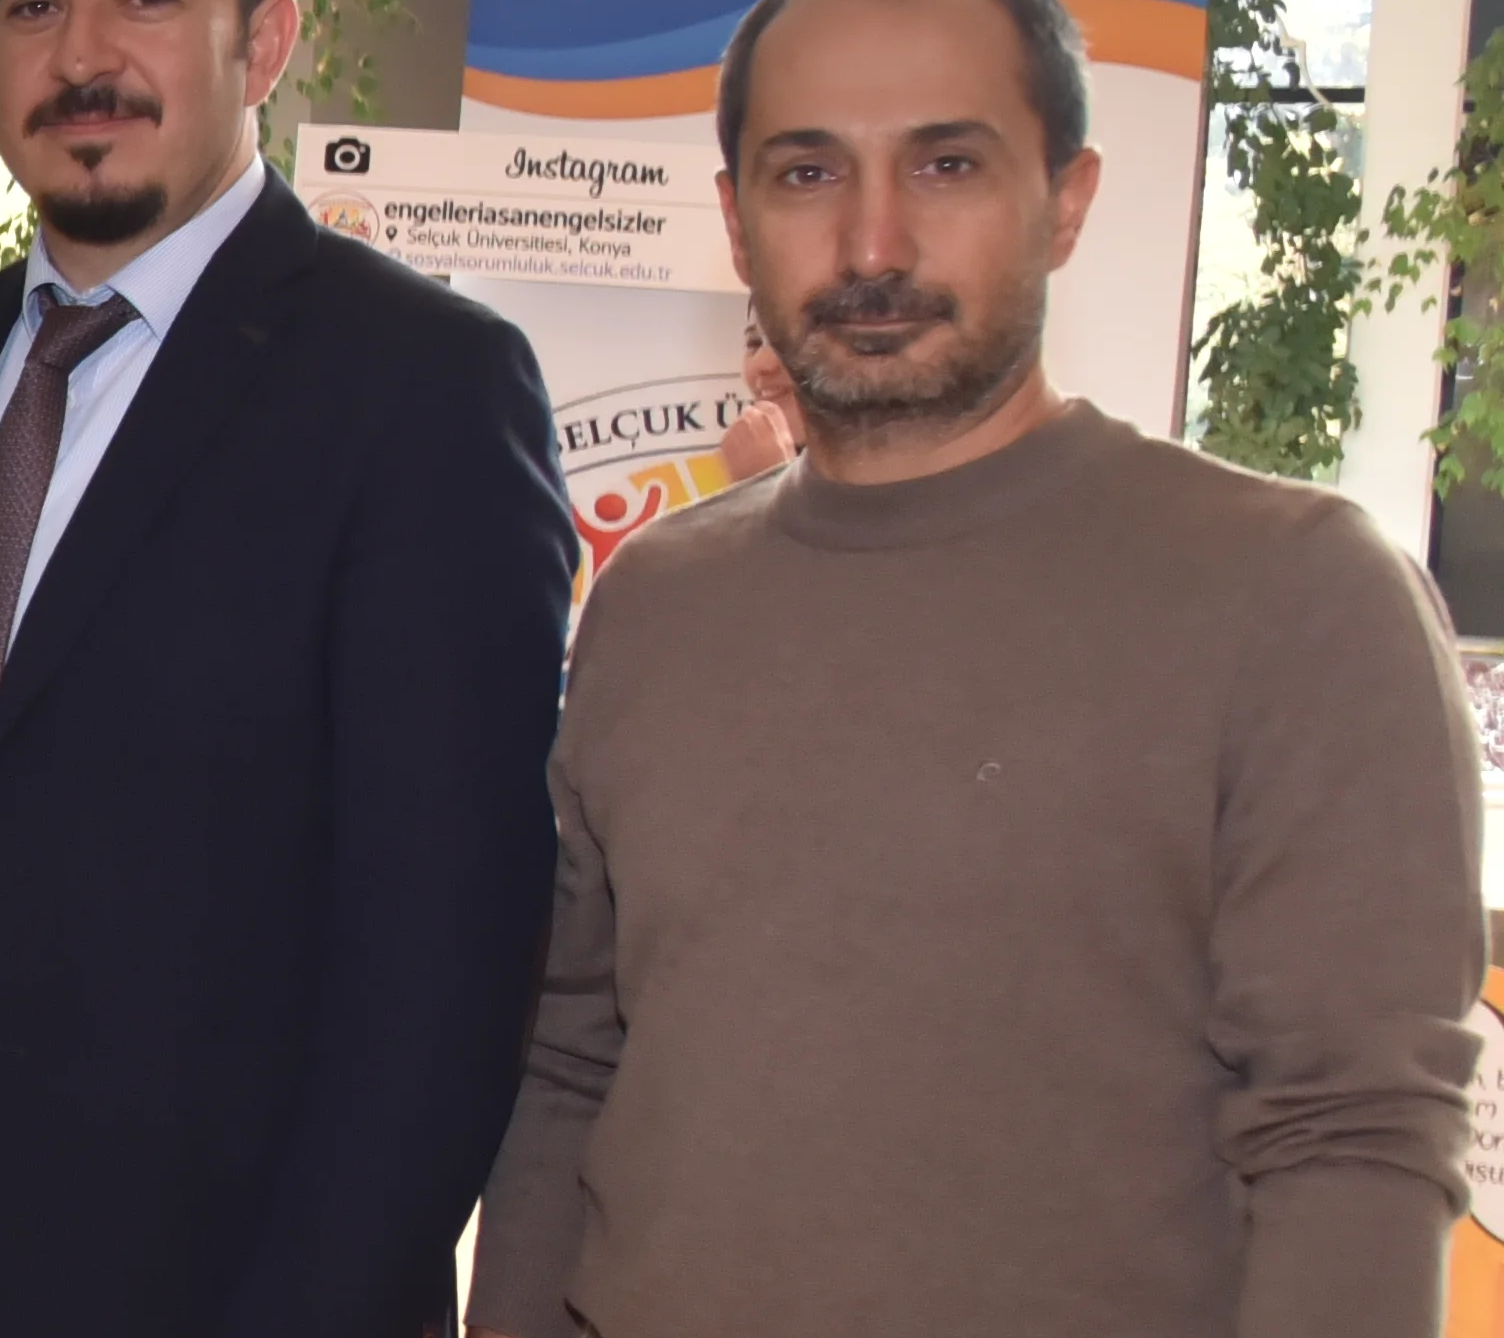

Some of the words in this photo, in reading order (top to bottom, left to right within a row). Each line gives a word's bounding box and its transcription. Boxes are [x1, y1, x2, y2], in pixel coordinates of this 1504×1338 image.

[504, 147, 669, 198] Instagram
[384, 200, 667, 237] engelleriasanengelsizler
[406, 227, 461, 248] Selçuk
[579, 240, 631, 260] Konya
[557, 401, 704, 453] ELÇUK
